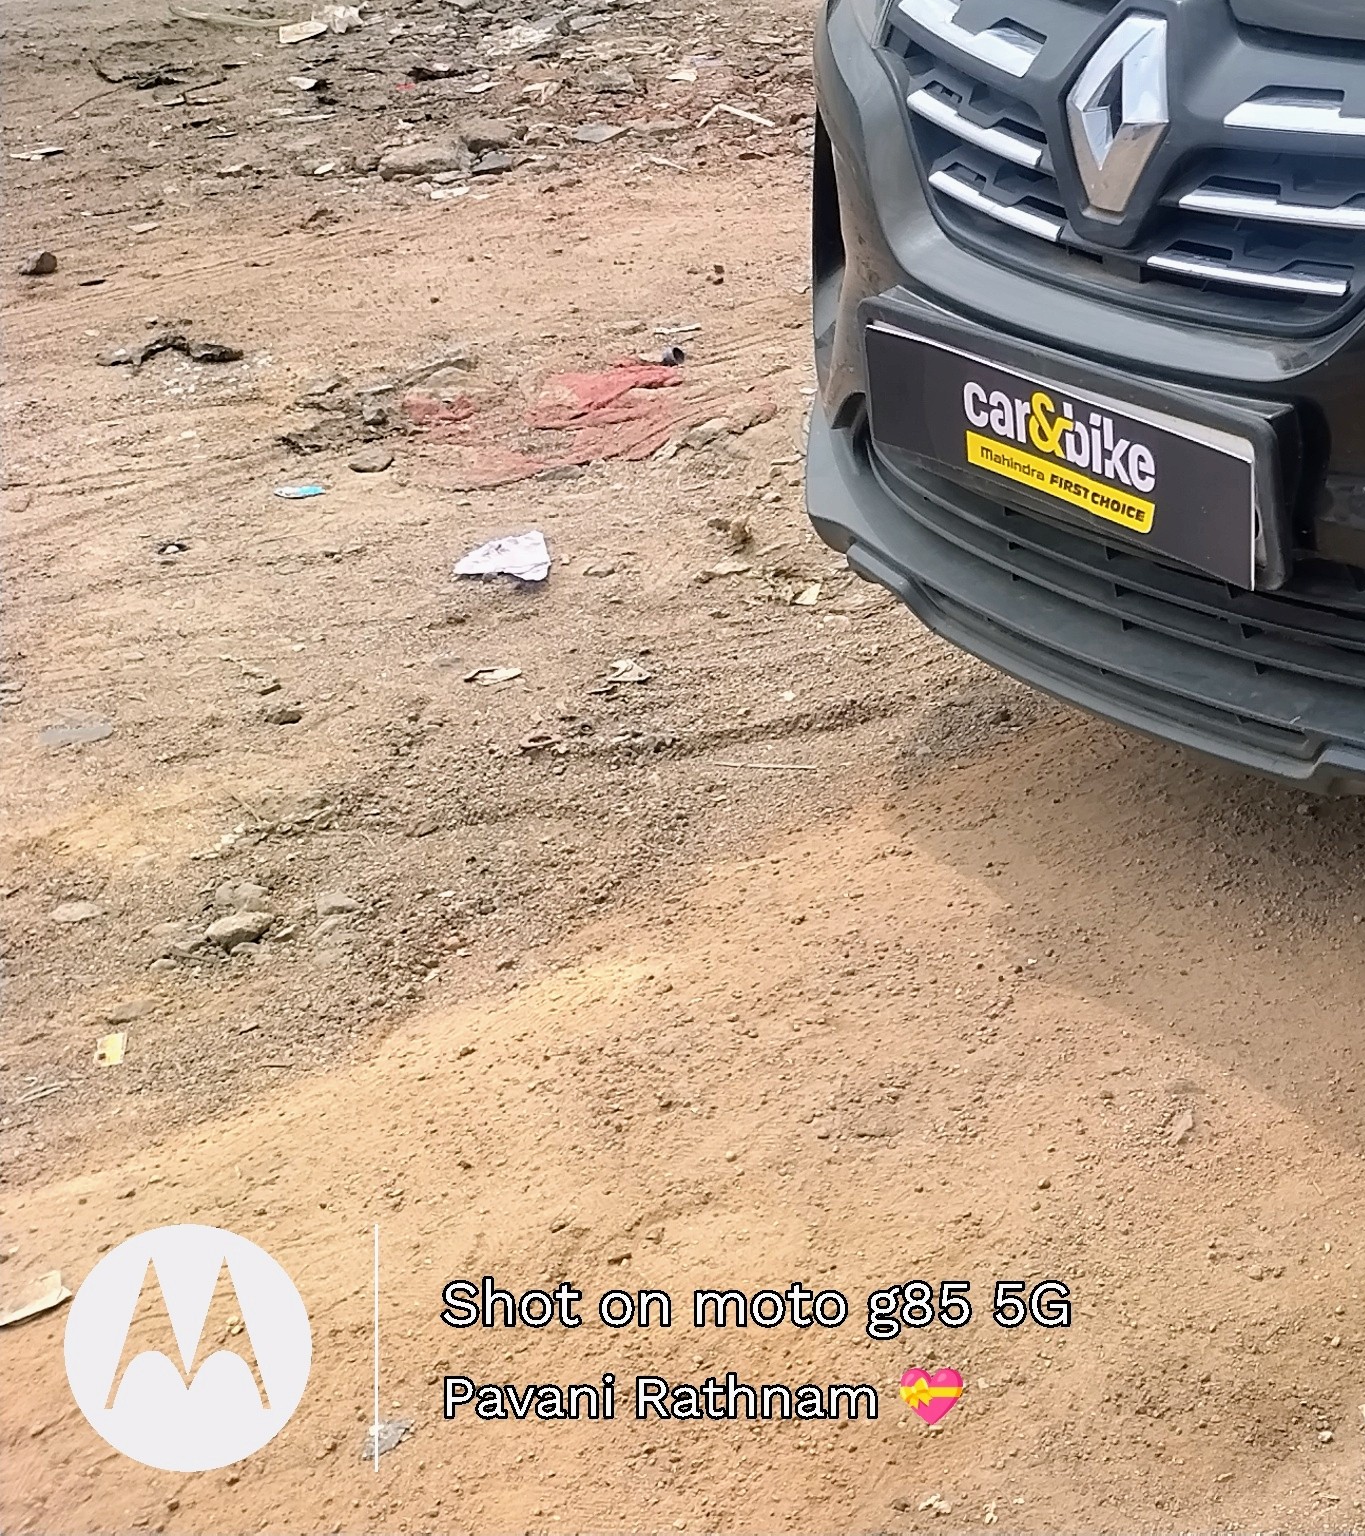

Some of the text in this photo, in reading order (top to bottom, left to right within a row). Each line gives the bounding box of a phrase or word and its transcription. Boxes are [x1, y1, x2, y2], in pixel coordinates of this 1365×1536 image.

[963, 381, 1156, 493] car&bike
[1049, 473, 1091, 499] FIRST
[1091, 492, 1146, 523] CHOICE
